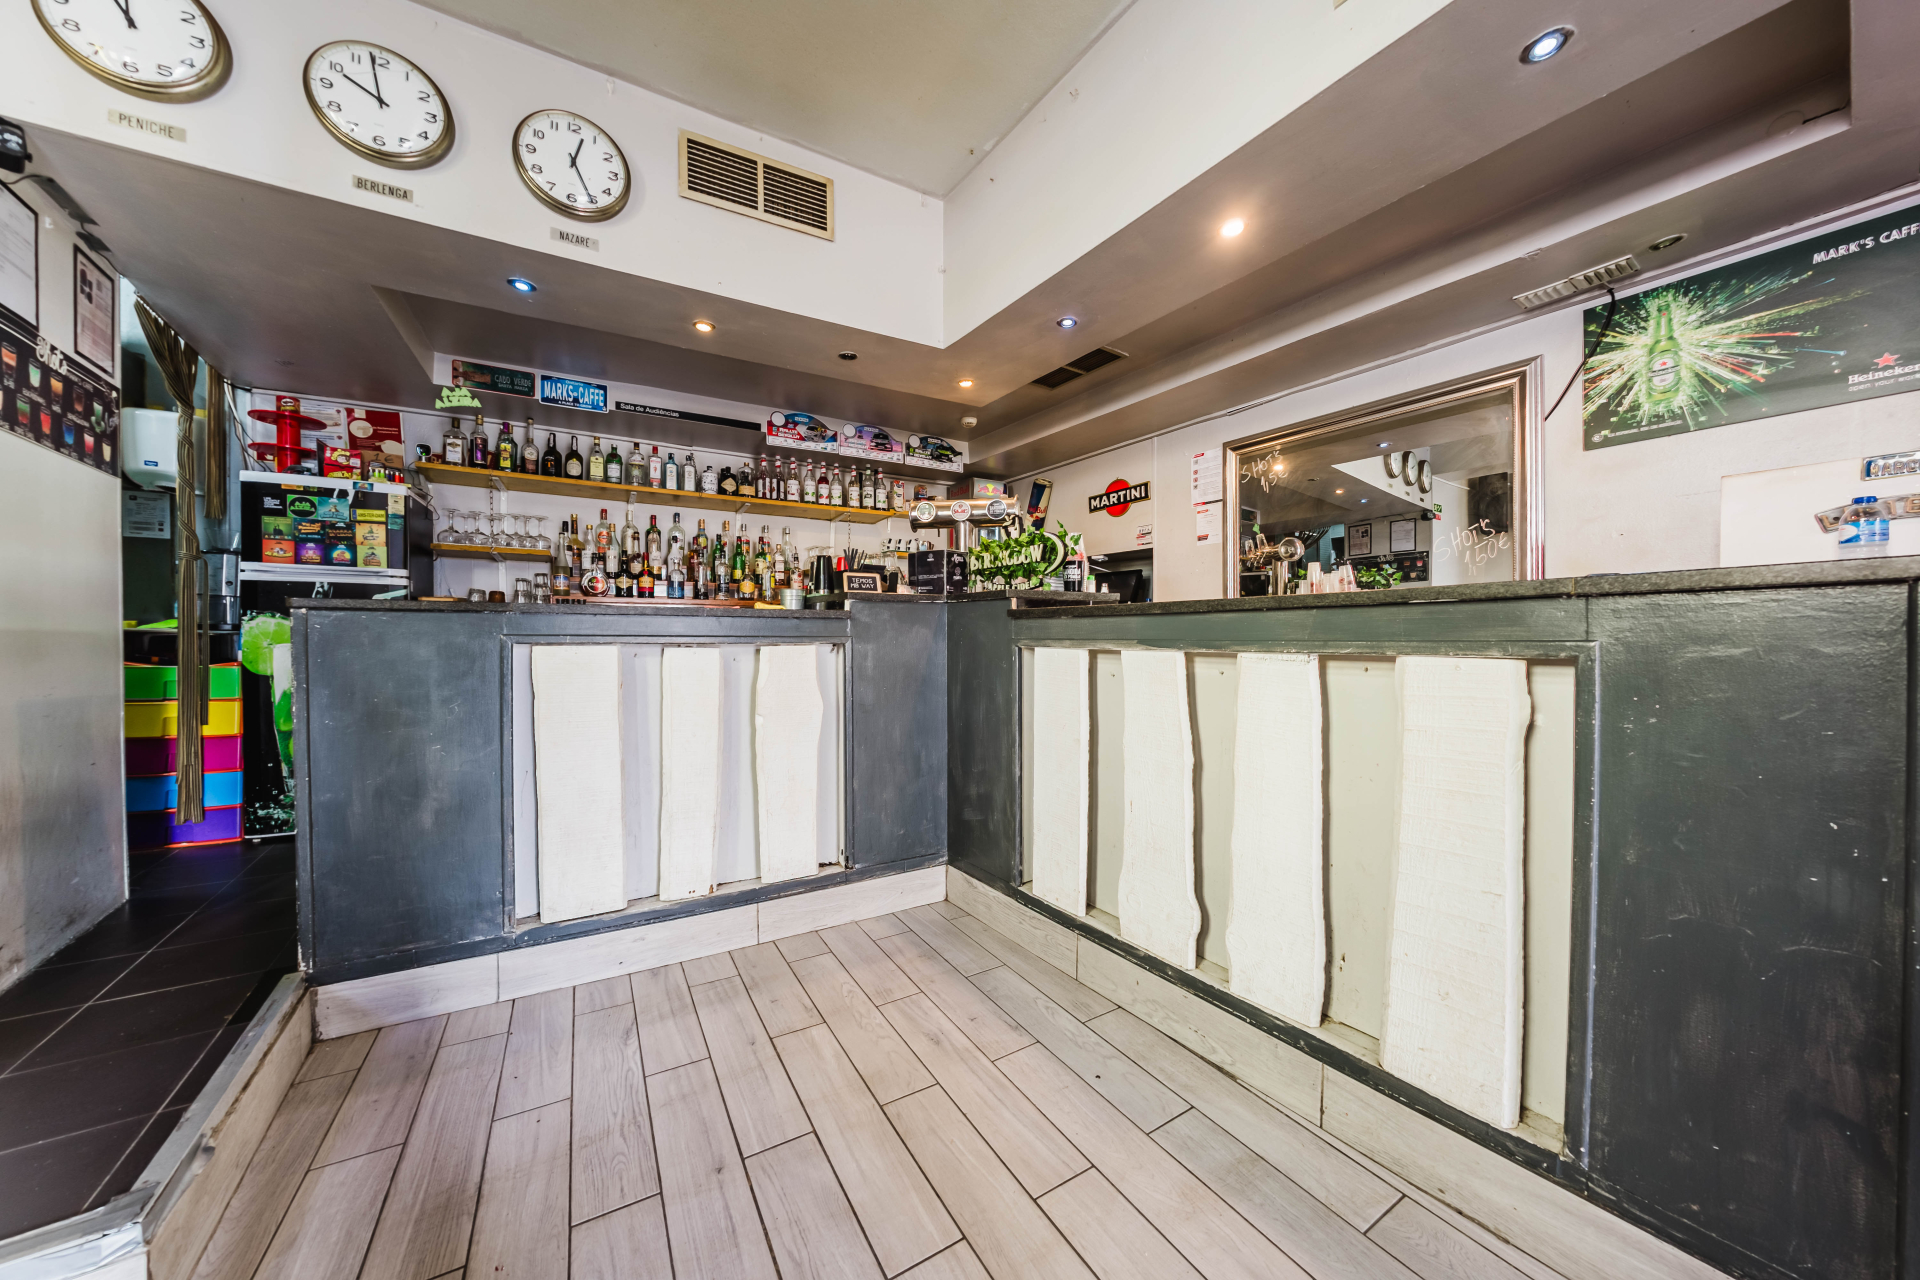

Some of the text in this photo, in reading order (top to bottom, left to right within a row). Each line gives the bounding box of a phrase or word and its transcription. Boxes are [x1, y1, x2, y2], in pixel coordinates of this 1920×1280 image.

[180, 10, 196, 25] 2
[62, 18, 81, 32] 8
[189, 35, 205, 50] 3
[180, 57, 196, 69] 4
[351, 51, 361, 65] 11
[372, 54, 390, 70] 12
[122, 60, 139, 73] 6
[157, 63, 173, 77] 5
[329, 60, 344, 74] 10
[406, 71, 409, 81] 1
[319, 77, 334, 89] 9
[417, 90, 431, 103] 2
[326, 100, 342, 112] 8
[423, 111, 438, 124] 3
[119, 112, 175, 140] PENICHE
[550, 120, 559, 132] 11
[567, 121, 582, 135] 12
[417, 130, 429, 141] 4
[532, 127, 545, 140] 10
[592, 135, 597, 145] 1
[372, 135, 386, 147] 6
[524, 143, 537, 154] 9
[602, 152, 613, 163] 2
[530, 163, 543, 175] 8
[607, 170, 619, 181] 3
[357, 177, 409, 200] BERLENGA
[546, 180, 556, 191] 7
[602, 187, 612, 197] 4
[566, 193, 577, 203] 6
[1812, 222, 1920, 264] MARK'S CAFF
[36, 336, 68, 376] Shots
[494, 374, 532, 388] CABO VERDE
[544, 380, 605, 407] MARKS CAFFE
[620, 403, 635, 411] Sala
[645, 407, 680, 418] Audiências
[1870, 459, 1920, 476] MARC
[960, 485, 970, 495] Bull
[1091, 485, 1146, 510] MARTINI
